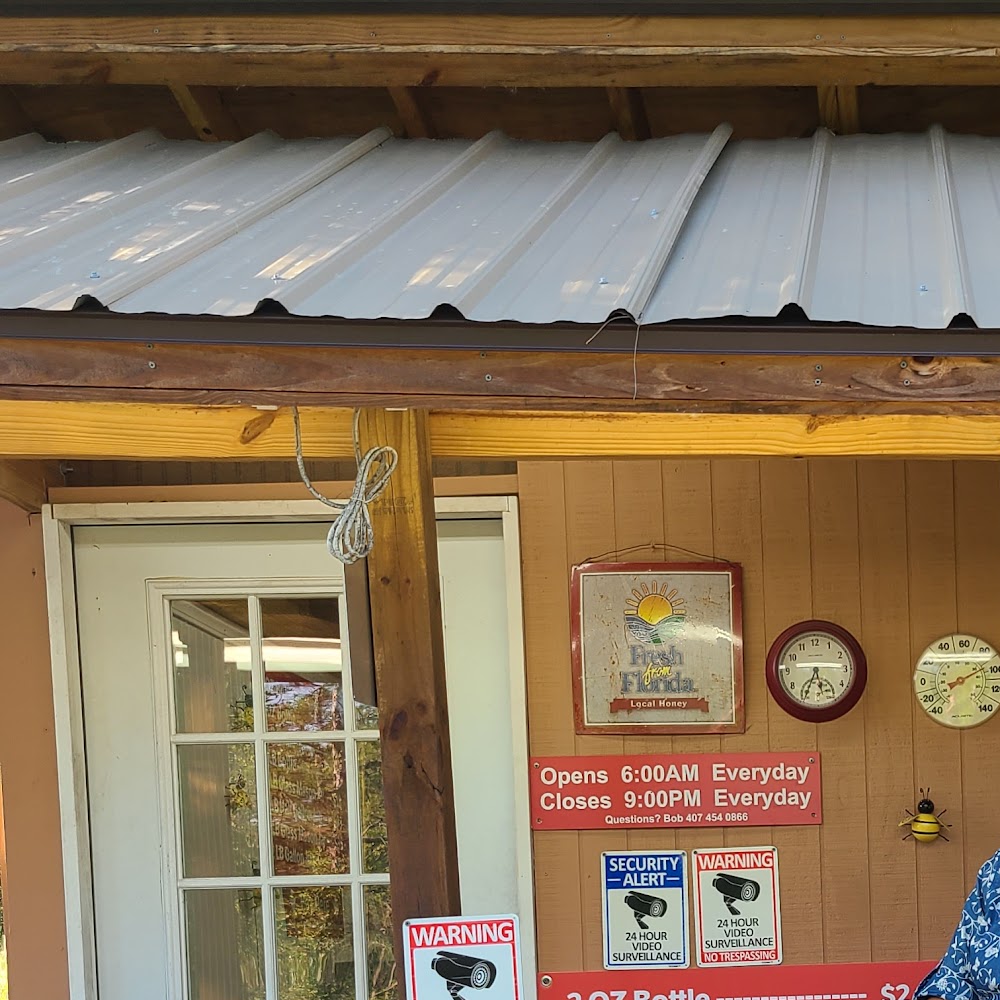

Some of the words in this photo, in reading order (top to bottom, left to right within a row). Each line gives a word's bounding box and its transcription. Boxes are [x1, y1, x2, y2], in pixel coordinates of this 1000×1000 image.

[798, 643, 805, 651] 11
[810, 639, 819, 647] 12
[959, 640, 970, 648] 60
[630, 645, 684, 665] Fresh
[789, 653, 797, 661] 10
[837, 651, 843, 659] 2
[643, 663, 672, 685] from
[785, 667, 790, 675] 9
[843, 665, 848, 673] 3
[621, 671, 695, 693] Florida
[920, 678, 926, 686] 0
[630, 700, 655, 709] Local
[659, 700, 687, 709] Honey
[978, 704, 993, 712] 140
[540, 767, 609, 789] Opens
[621, 764, 699, 783] 6:00AM
[712, 763, 810, 784] Everyday
[540, 792, 612, 811] Closes
[624, 790, 701, 809] 9:00PM
[714, 788, 812, 810] Everyday
[605, 814, 661, 825] Questions?
[663, 813, 684, 824] Bob
[685, 813, 703, 823] 407
[705, 812, 724, 822] 454
[724, 812, 748, 822] 0866
[609, 856, 680, 872] SECURITY
[698, 852, 773, 870] WARNING
[622, 872, 667, 887] ALERT
[717, 919, 729, 928] 24
[730, 917, 759, 927] HOUR
[411, 922, 513, 947] WARNING
[625, 932, 637, 941] 24
[639, 931, 668, 941] HOUR
[723, 928, 754, 938] VIDEO
[632, 941, 662, 951] VIDEO
[705, 937, 773, 949] SURVEILLANCE
[612, 951, 682, 962] SURVEILLANCE
[704, 952, 719, 963] NO
[719, 950, 776, 962] TRESPASSING
